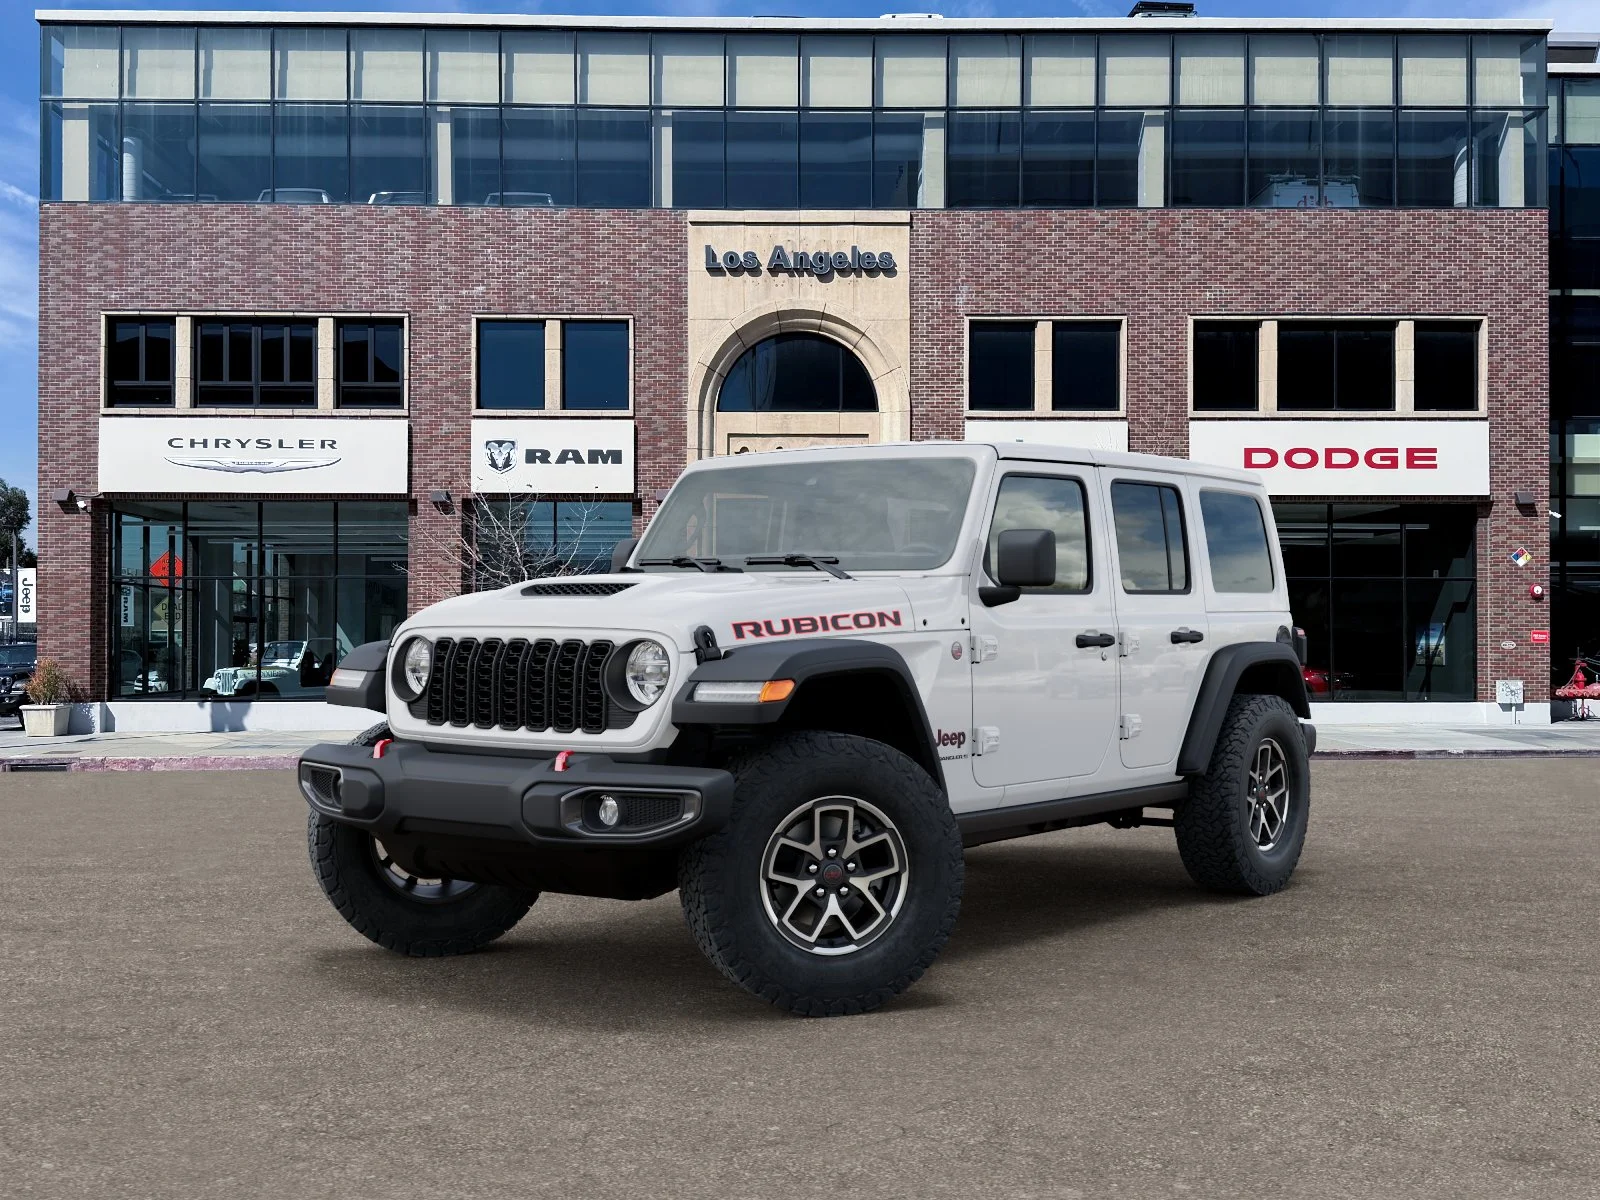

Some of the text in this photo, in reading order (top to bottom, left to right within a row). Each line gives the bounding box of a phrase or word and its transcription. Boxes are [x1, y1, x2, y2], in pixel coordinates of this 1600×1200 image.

[1297, 195, 1334, 208] dih
[704, 244, 895, 275] Los Angeles
[167, 437, 338, 450] CHRYSLER
[525, 448, 623, 465] RAM
[1243, 447, 1438, 470] DODGE
[20, 577, 34, 613] Jeep
[161, 603, 183, 611] DAD
[165, 612, 181, 620] ED
[731, 610, 902, 641] RUBICON
[935, 728, 966, 749] Jeep
